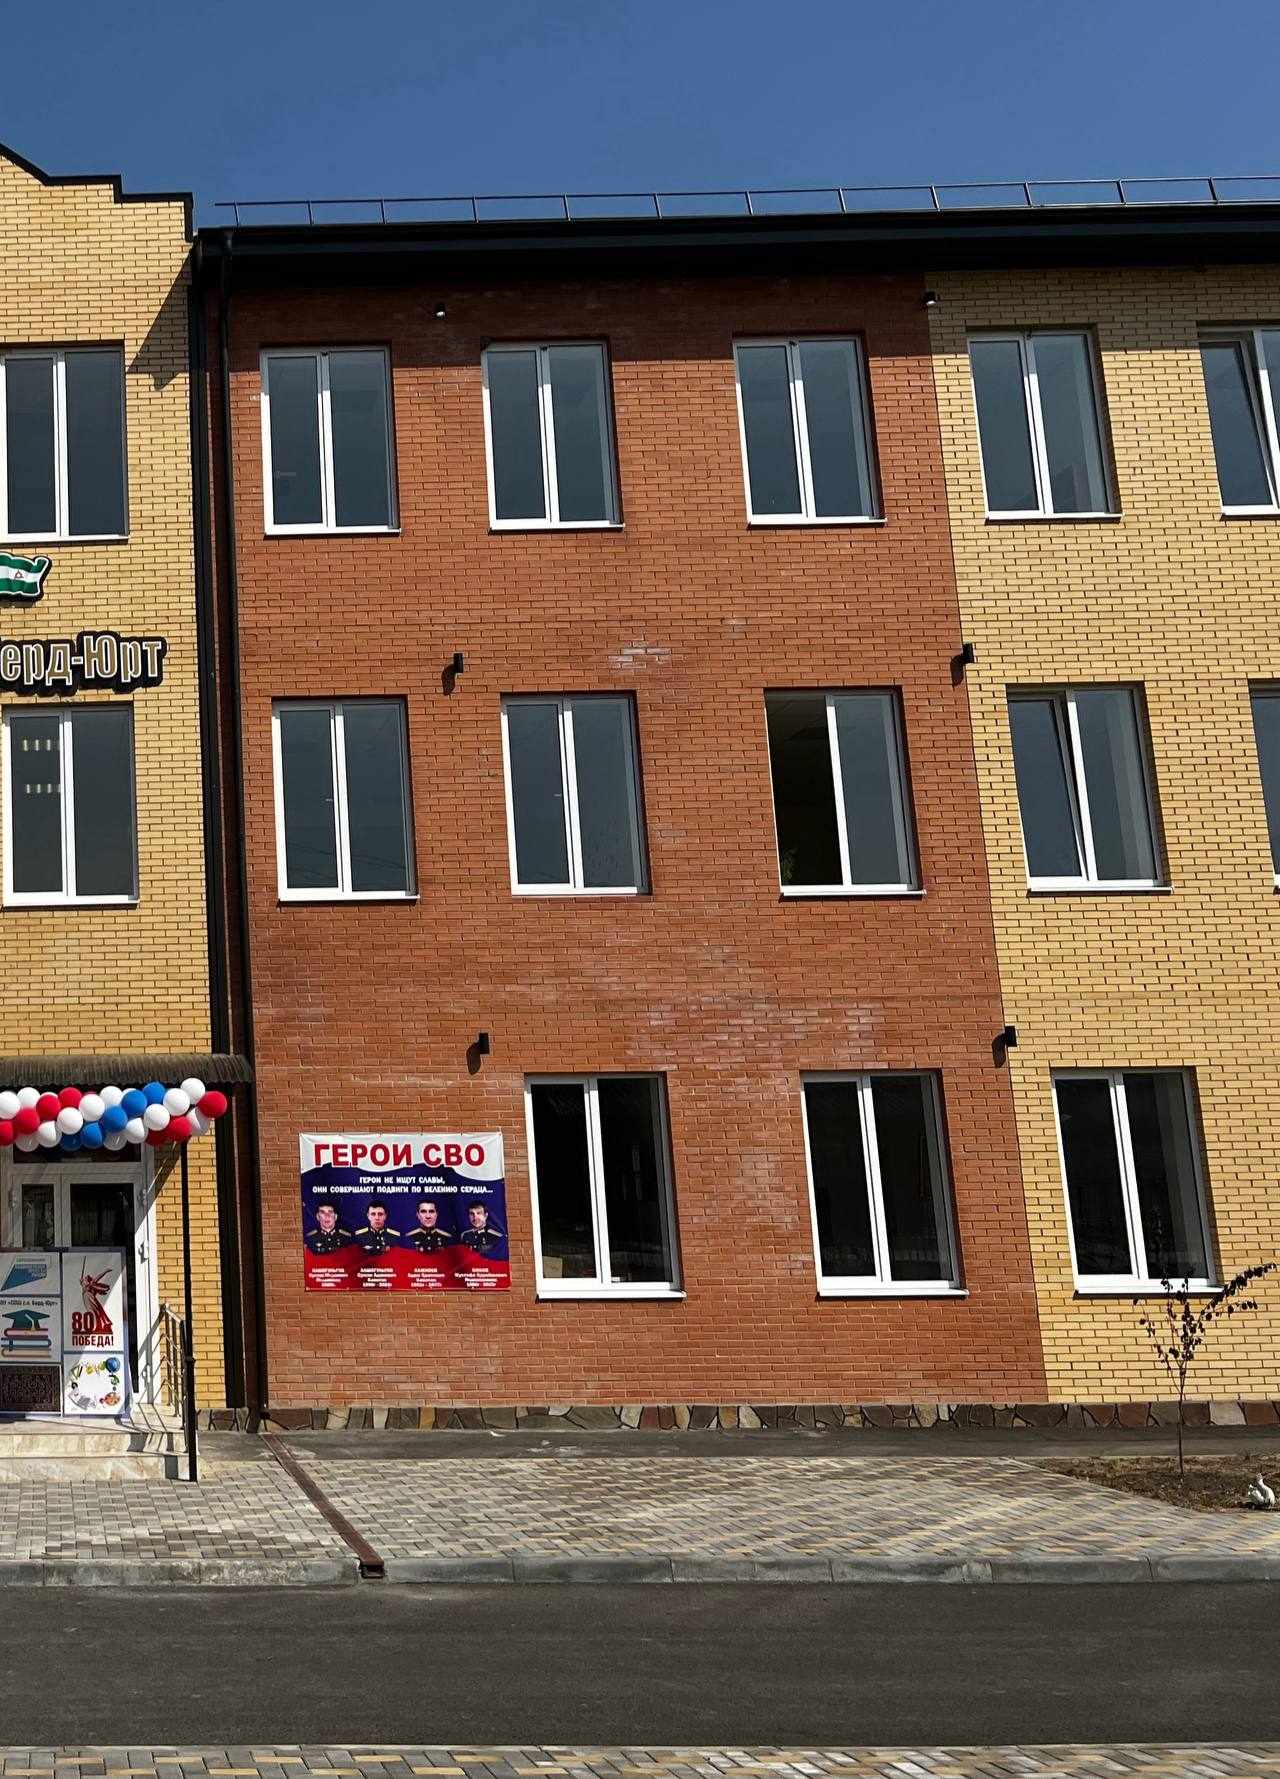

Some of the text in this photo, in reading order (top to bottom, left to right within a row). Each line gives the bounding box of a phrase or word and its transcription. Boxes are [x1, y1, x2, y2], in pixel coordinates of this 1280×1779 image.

[314, 1143, 485, 1167] ГЕРОИ СВО
[359, 1176, 381, 1184] ГЕРОИ
[384, 1176, 394, 1184] НЕ
[396, 1176, 416, 1185] ИЩУТ
[377, 1186, 409, 1194] ПОДВИГИ
[71, 1311, 95, 1331] 80
[71, 1335, 114, 1348] ПОБЕДА!
